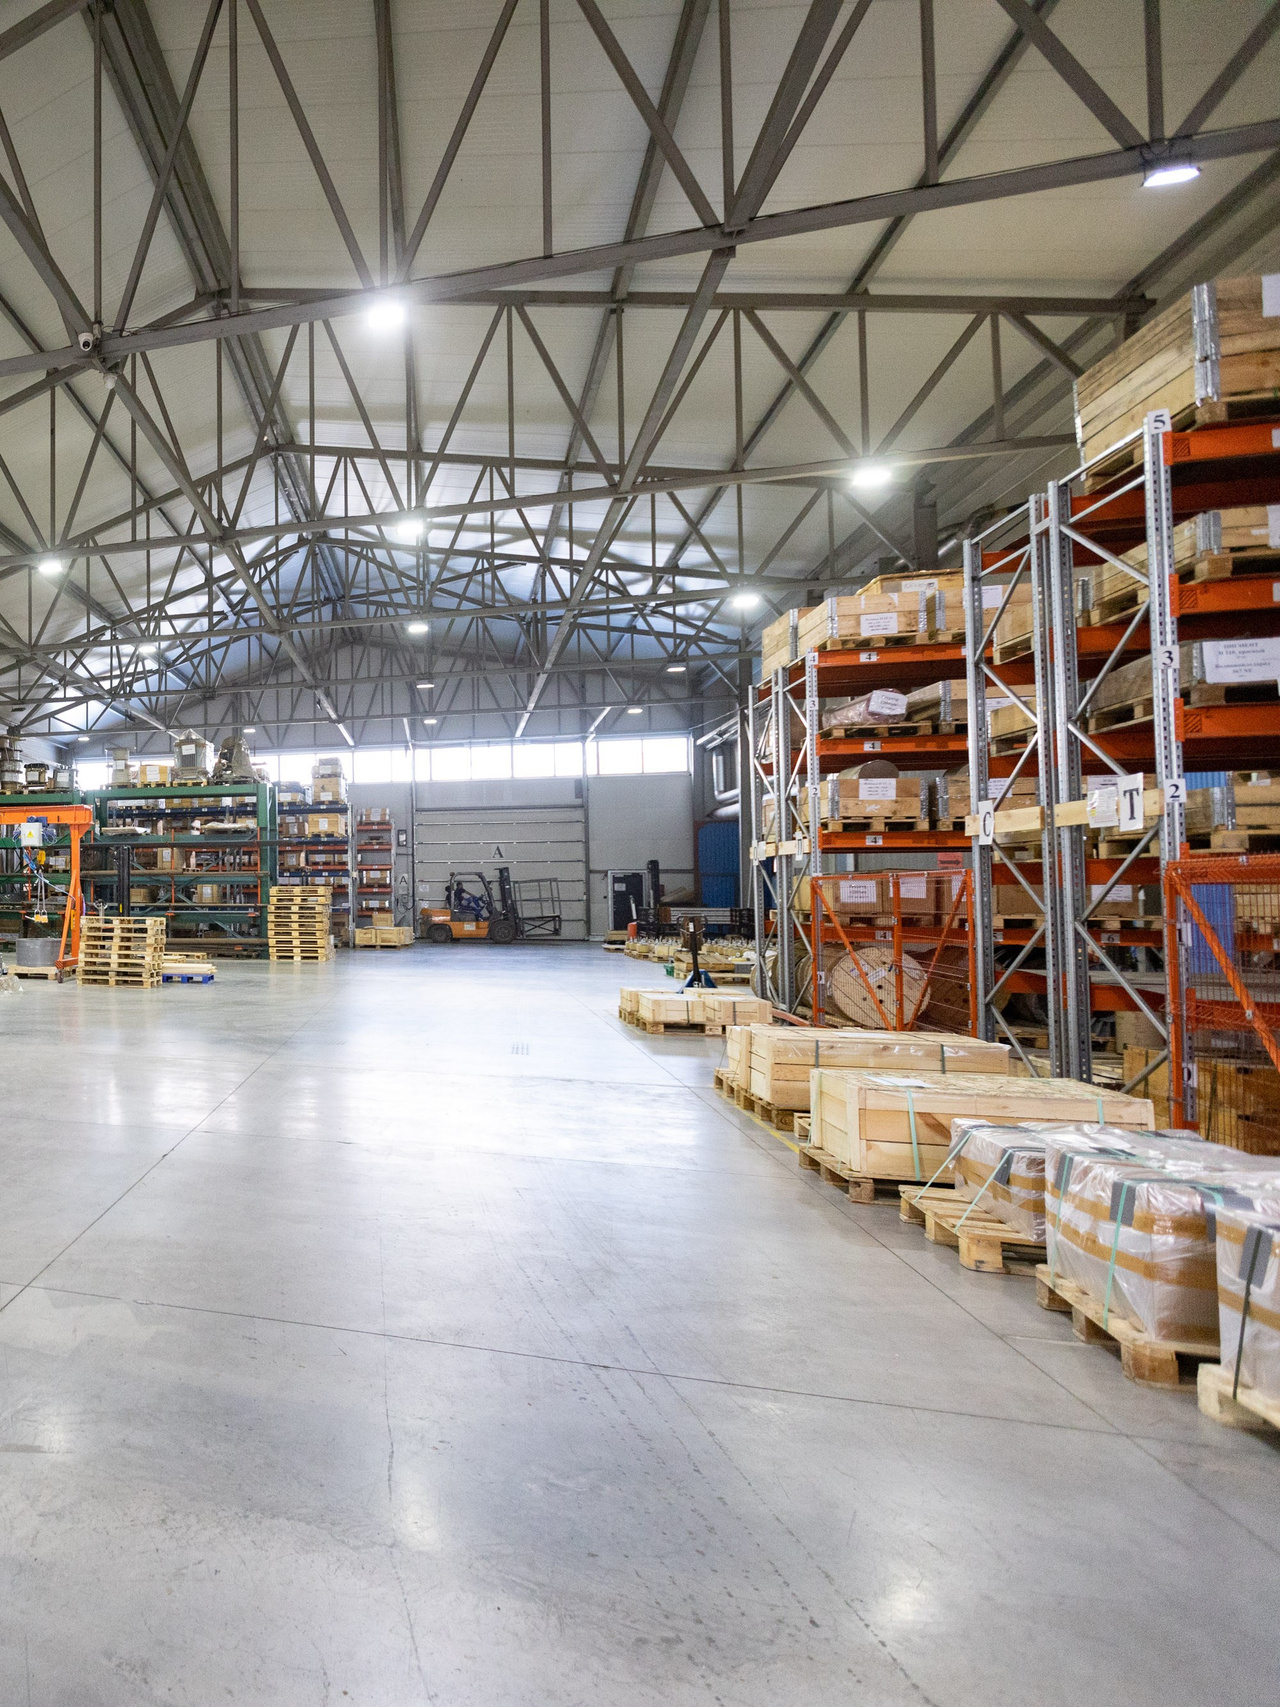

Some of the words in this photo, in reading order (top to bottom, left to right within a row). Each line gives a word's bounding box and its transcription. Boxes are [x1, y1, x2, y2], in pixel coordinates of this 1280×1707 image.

[1153, 414, 1166, 430] 5
[865, 653, 872, 661] 4
[1162, 650, 1174, 666] 3
[809, 699, 816, 708] 3
[868, 742, 876, 750] 4
[812, 787, 818, 796] 2
[1169, 783, 1181, 799] 2
[870, 836, 878, 844] 4
[1107, 934, 1115, 942] 6
